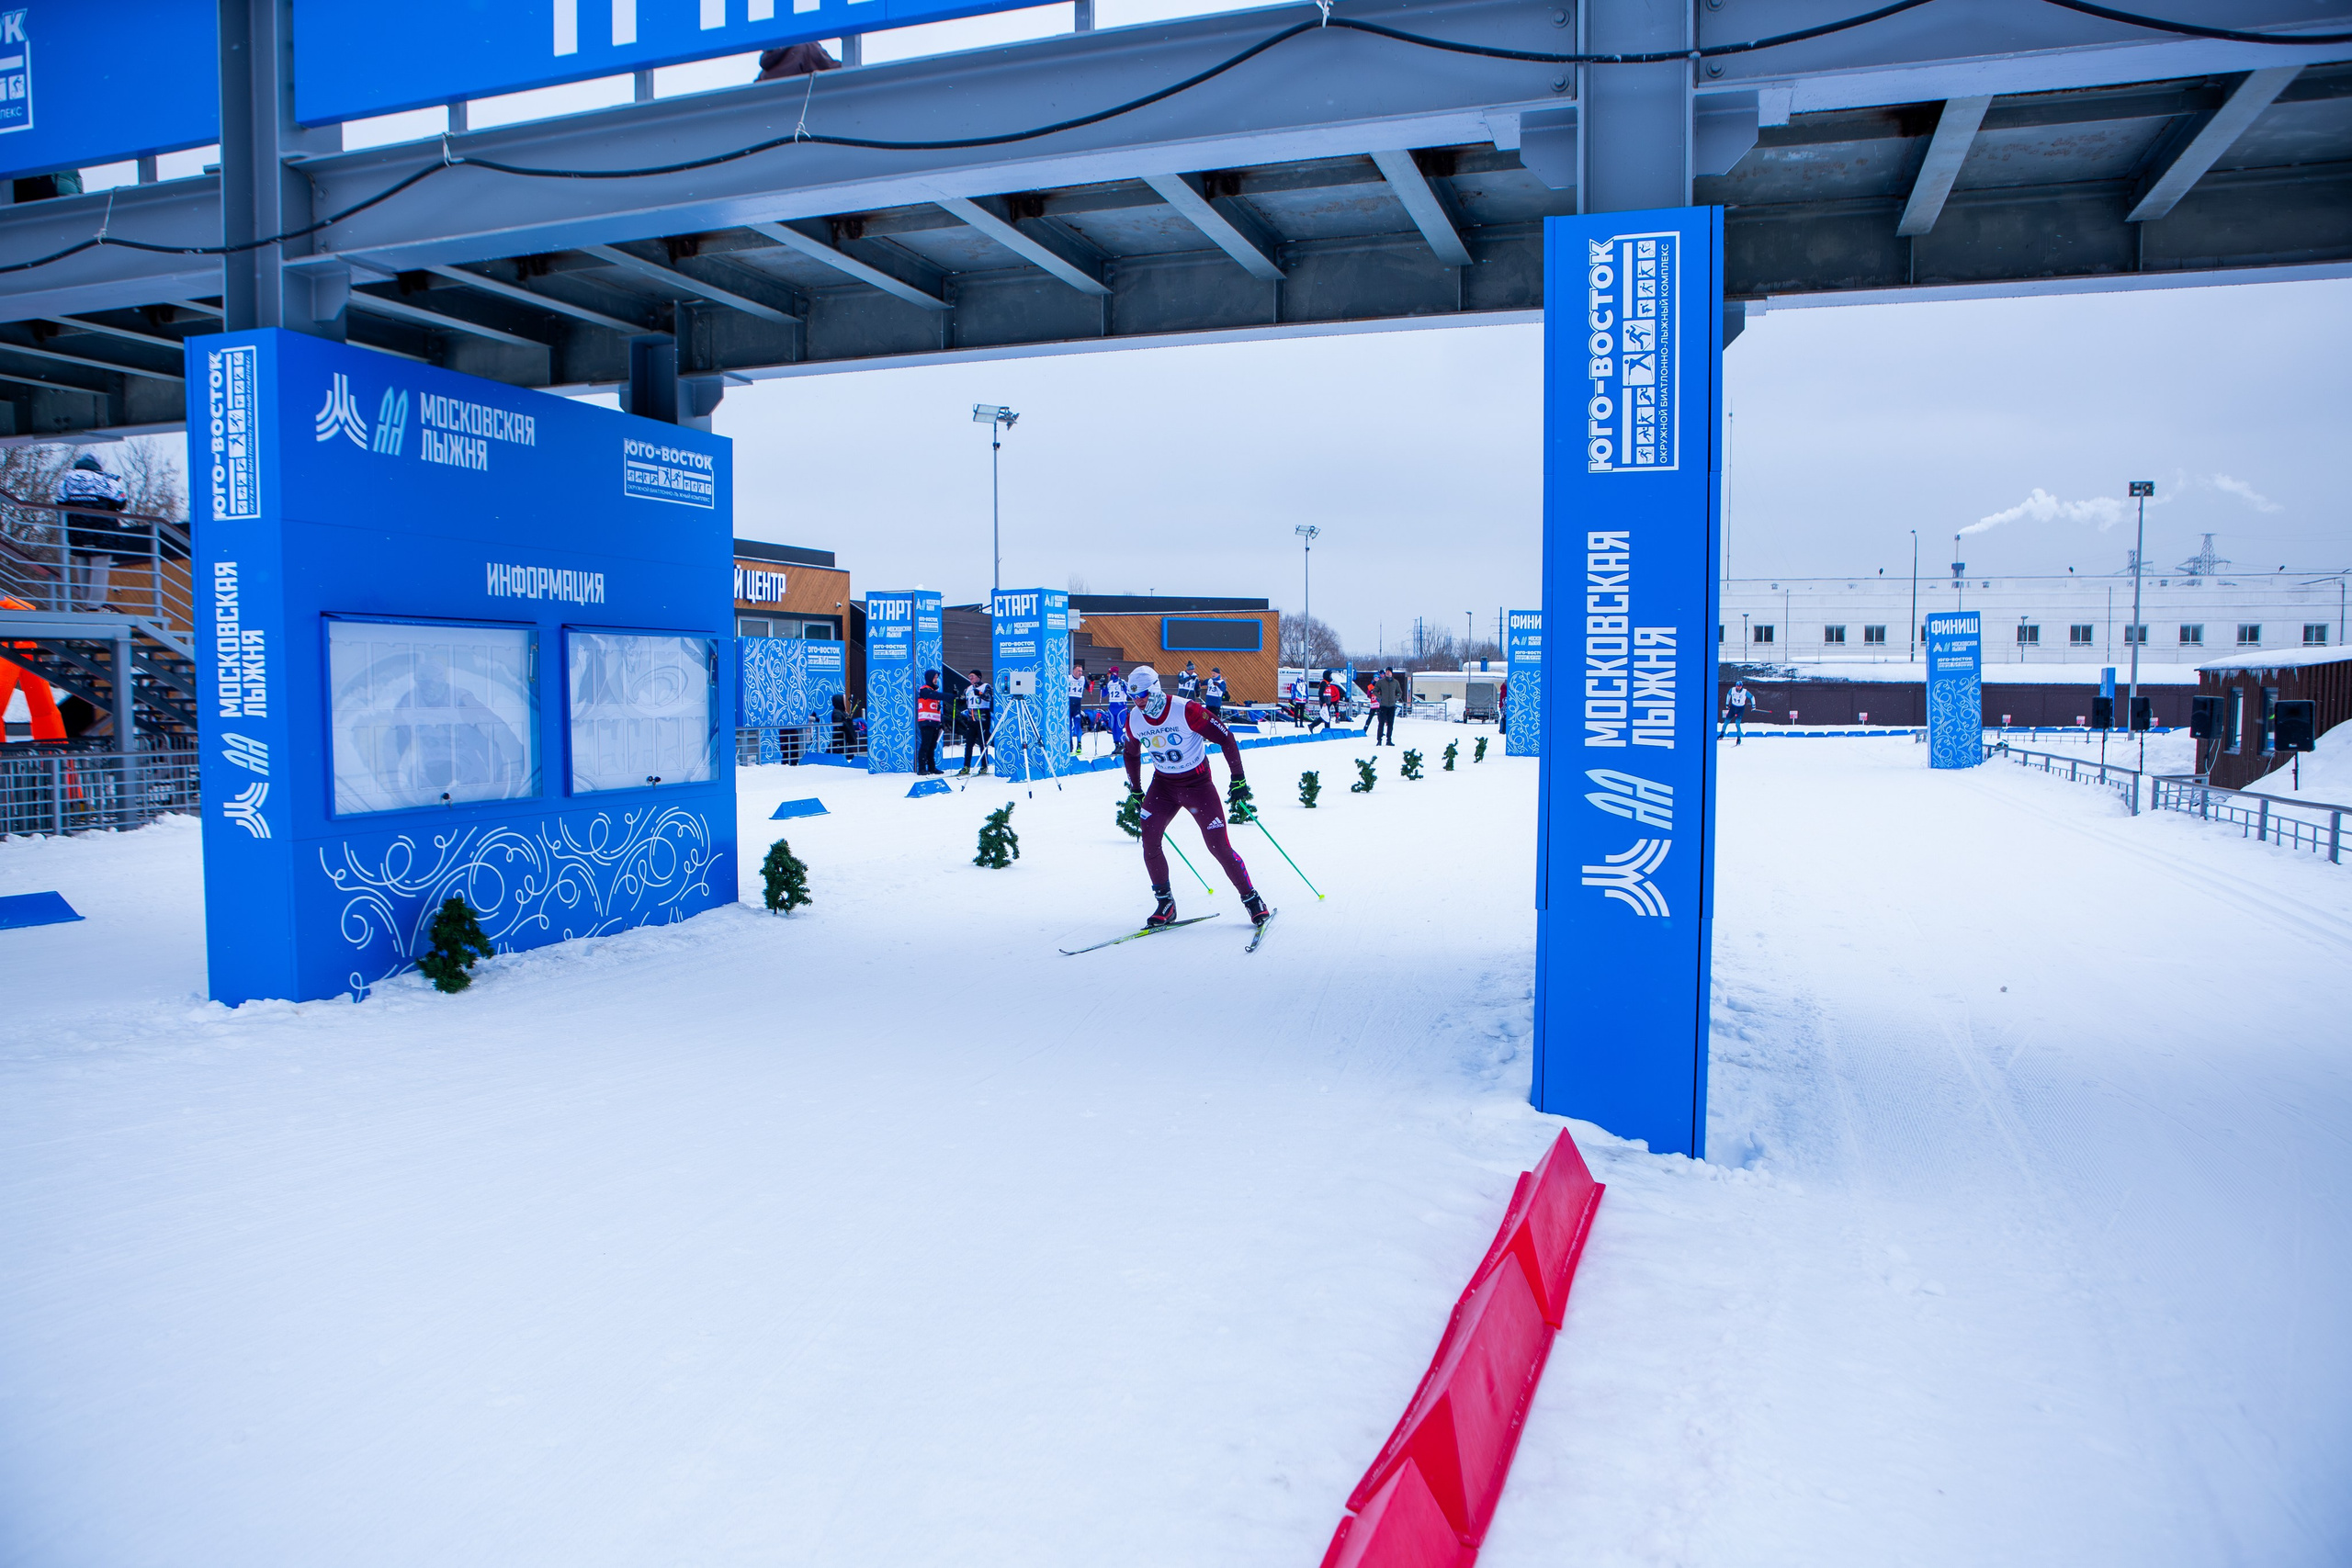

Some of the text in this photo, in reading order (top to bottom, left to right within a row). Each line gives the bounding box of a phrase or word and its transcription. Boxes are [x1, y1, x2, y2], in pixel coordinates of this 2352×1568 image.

[1588, 238, 1614, 473] ЮГО-ВОСТОК
[1658, 243, 1669, 464] ОКРУЖНОЙ БИАТЛОННО-ЛЫЖНЫЙ КОМПЛЕКС
[209, 351, 228, 521] ЮГО-ВОСТОК
[420, 391, 536, 446] МОСКОВСКАЯ
[420, 428, 488, 471] ЛЫЖНЯ
[624, 438, 713, 470] ЮГО-ВОСТОК
[487, 562, 605, 606] ИНФОРМАЦИЯ
[746, 570, 786, 604] ЦЕНТР
[994, 594, 1038, 617] СТАРТ
[868, 600, 913, 621] СТАРТ
[1510, 615, 1542, 629] ФИНИ
[1931, 617, 1978, 635] ФИНИШ
[214, 561, 243, 717] МОСКОВСКАЯ
[1585, 531, 1630, 747] МОСКОВСКАЯ
[241, 629, 267, 717] ЛЫЖНЯ
[1632, 627, 1677, 749] ЛЫЖНЯ
[1210, 717, 1228, 736] SCANIA
